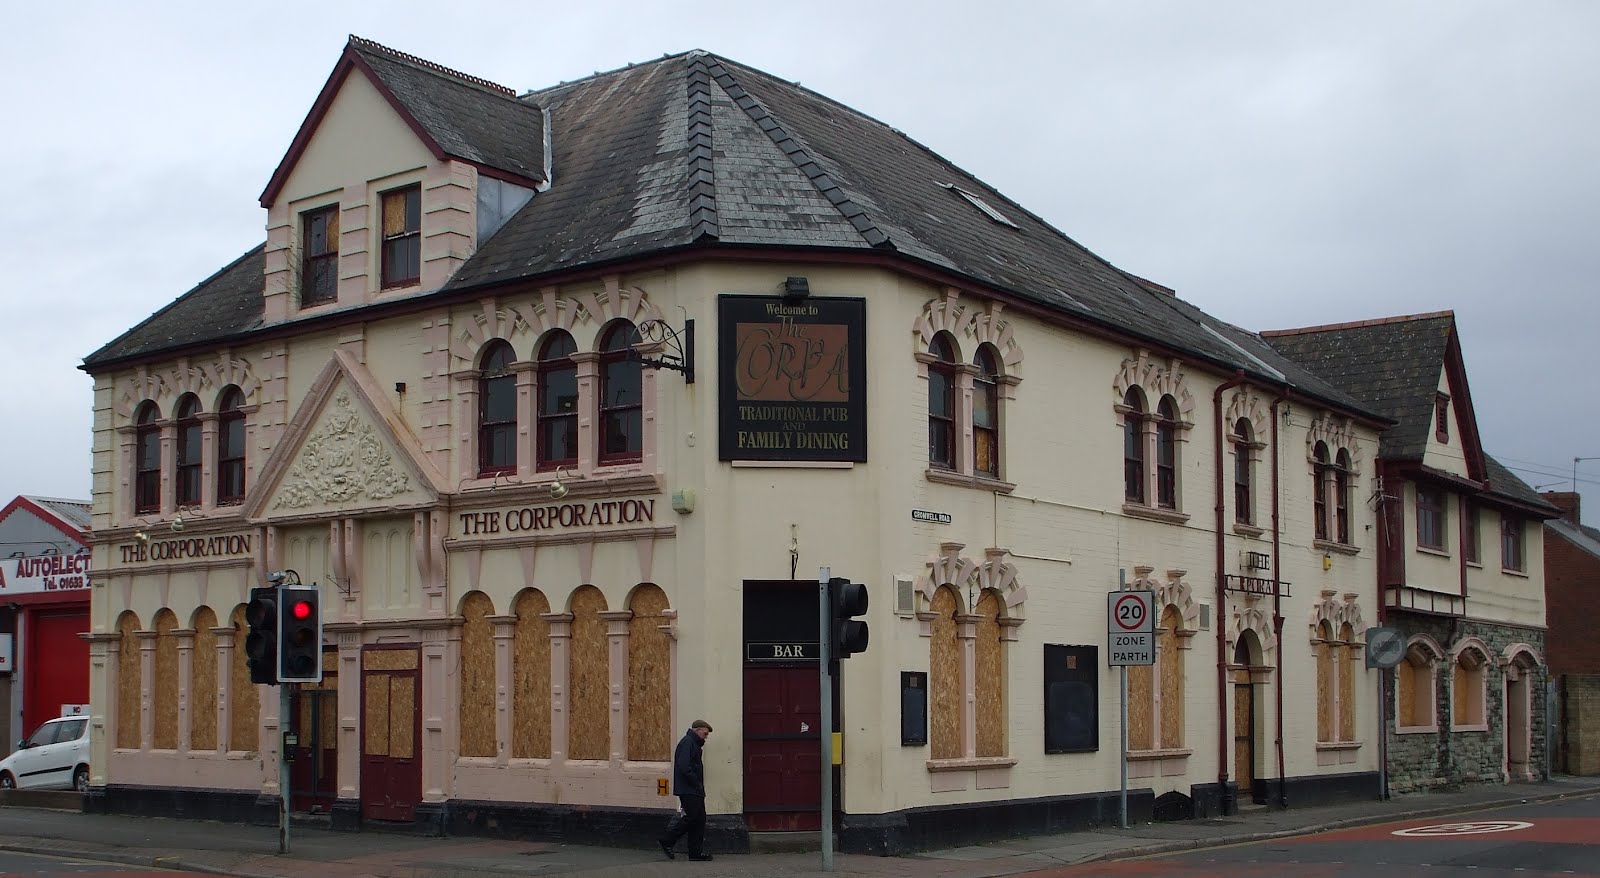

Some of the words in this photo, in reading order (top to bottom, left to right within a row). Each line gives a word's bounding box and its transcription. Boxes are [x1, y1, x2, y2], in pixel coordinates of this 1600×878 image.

[766, 303, 807, 315] Welcome
[809, 304, 818, 315] to
[776, 314, 808, 339] The
[738, 406, 820, 421] TRADITIONAL
[823, 407, 848, 422] PUB
[783, 422, 805, 430] AND
[737, 431, 793, 449] FAMILY
[796, 432, 849, 449] DINING
[460, 511, 500, 535] THE
[505, 499, 654, 532] CORPORATION
[120, 544, 148, 563] THE
[150, 534, 251, 561] CORPORATION
[59, 576, 83, 589] 01633
[1120, 605, 1142, 620] 20
[1116, 636, 1145, 646] ZONE
[773, 645, 804, 658] BAR
[1113, 652, 1148, 661] PARTH
